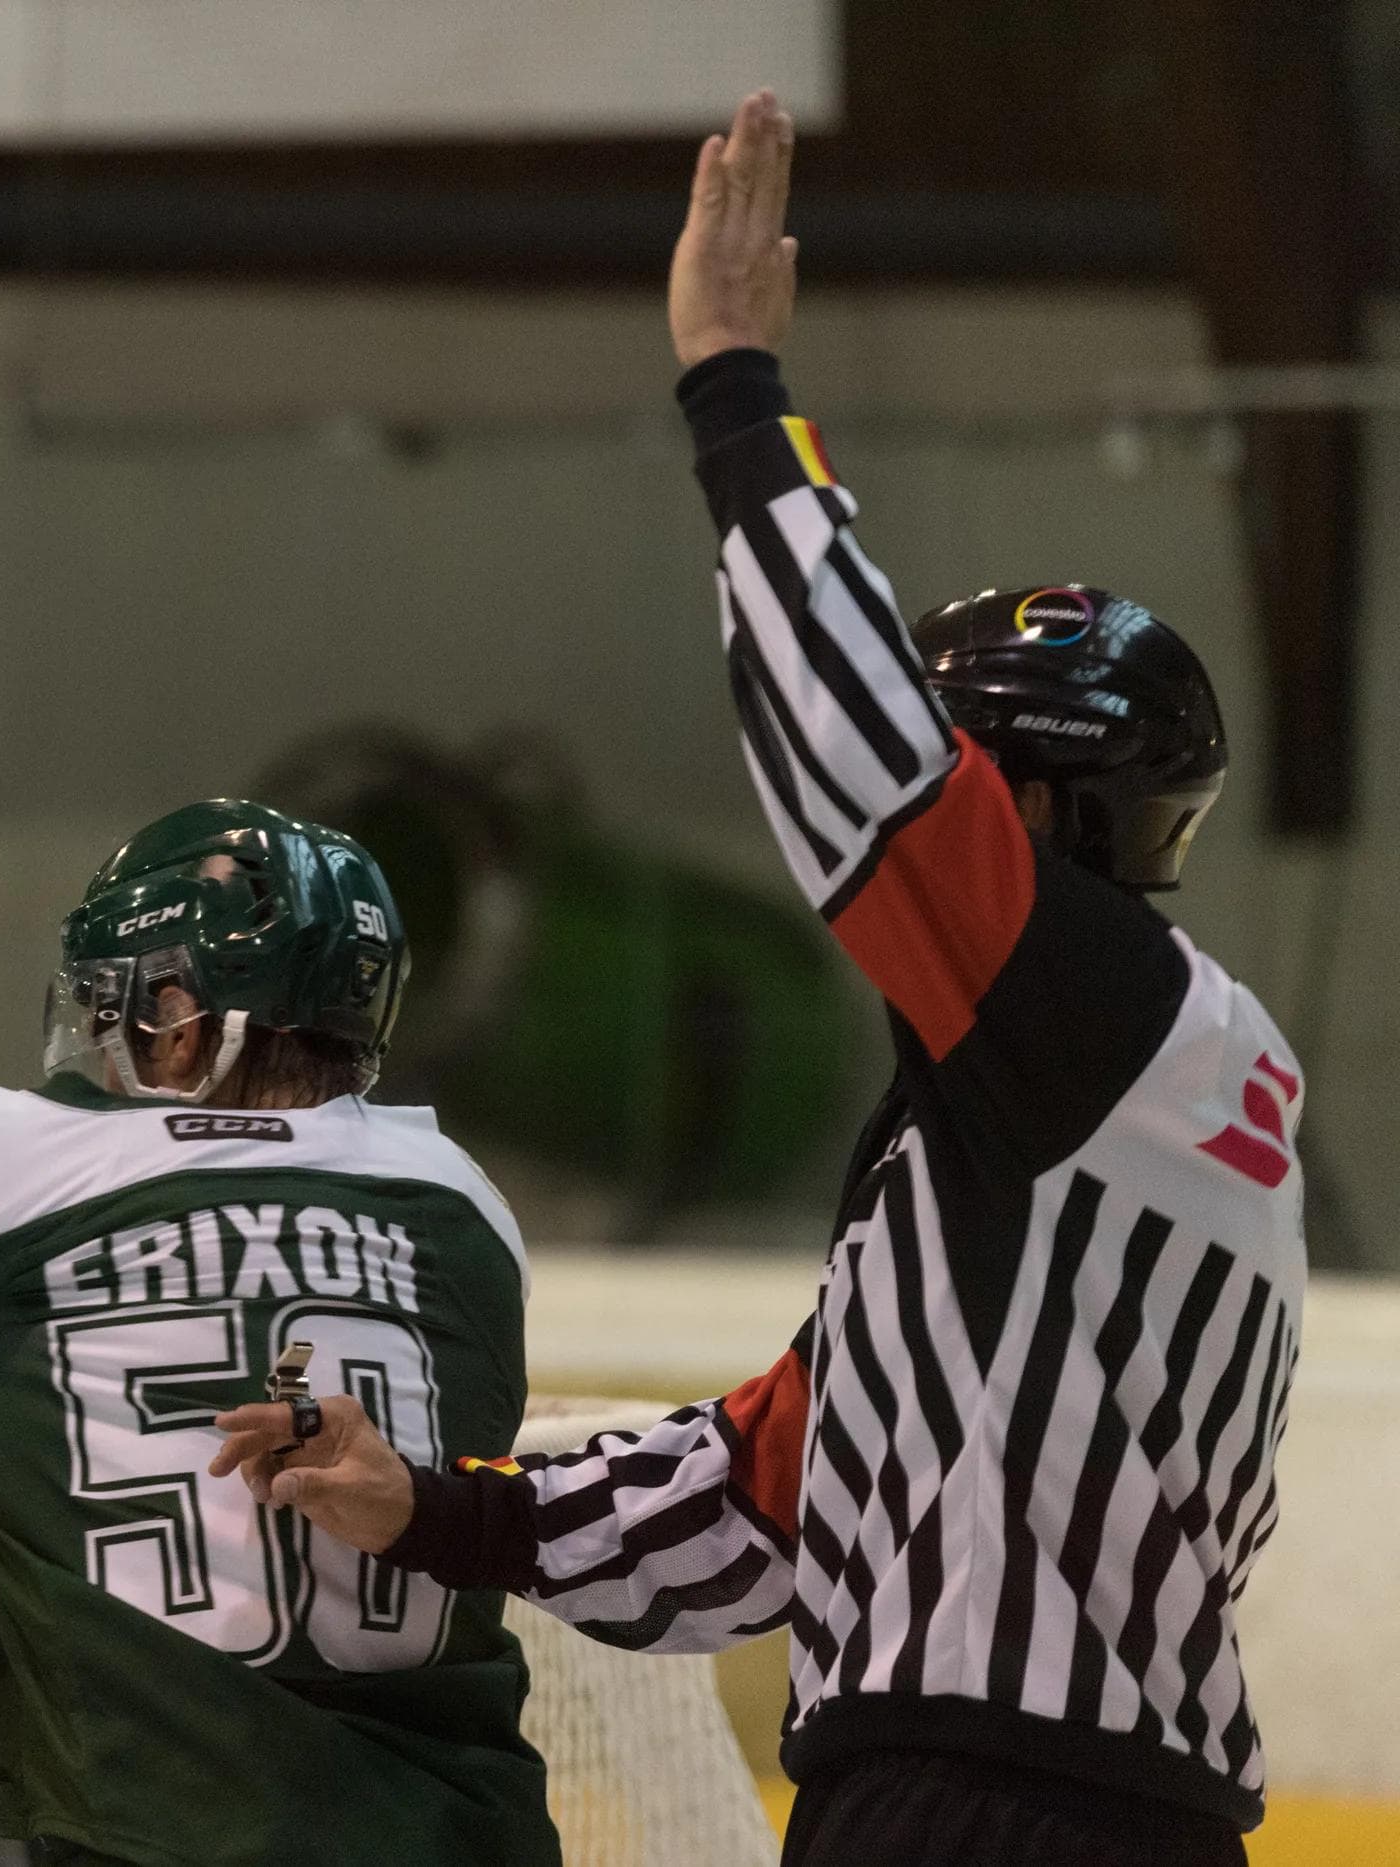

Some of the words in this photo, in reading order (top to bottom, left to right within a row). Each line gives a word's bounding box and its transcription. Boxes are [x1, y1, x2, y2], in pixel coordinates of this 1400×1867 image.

[1011, 713, 1107, 740] BAUER
[116, 902, 187, 937] CCM
[352, 899, 389, 942] 50
[173, 1117, 285, 1134] CCM
[43, 1203, 420, 1314] ERIXON
[46, 1298, 458, 1672] 50
